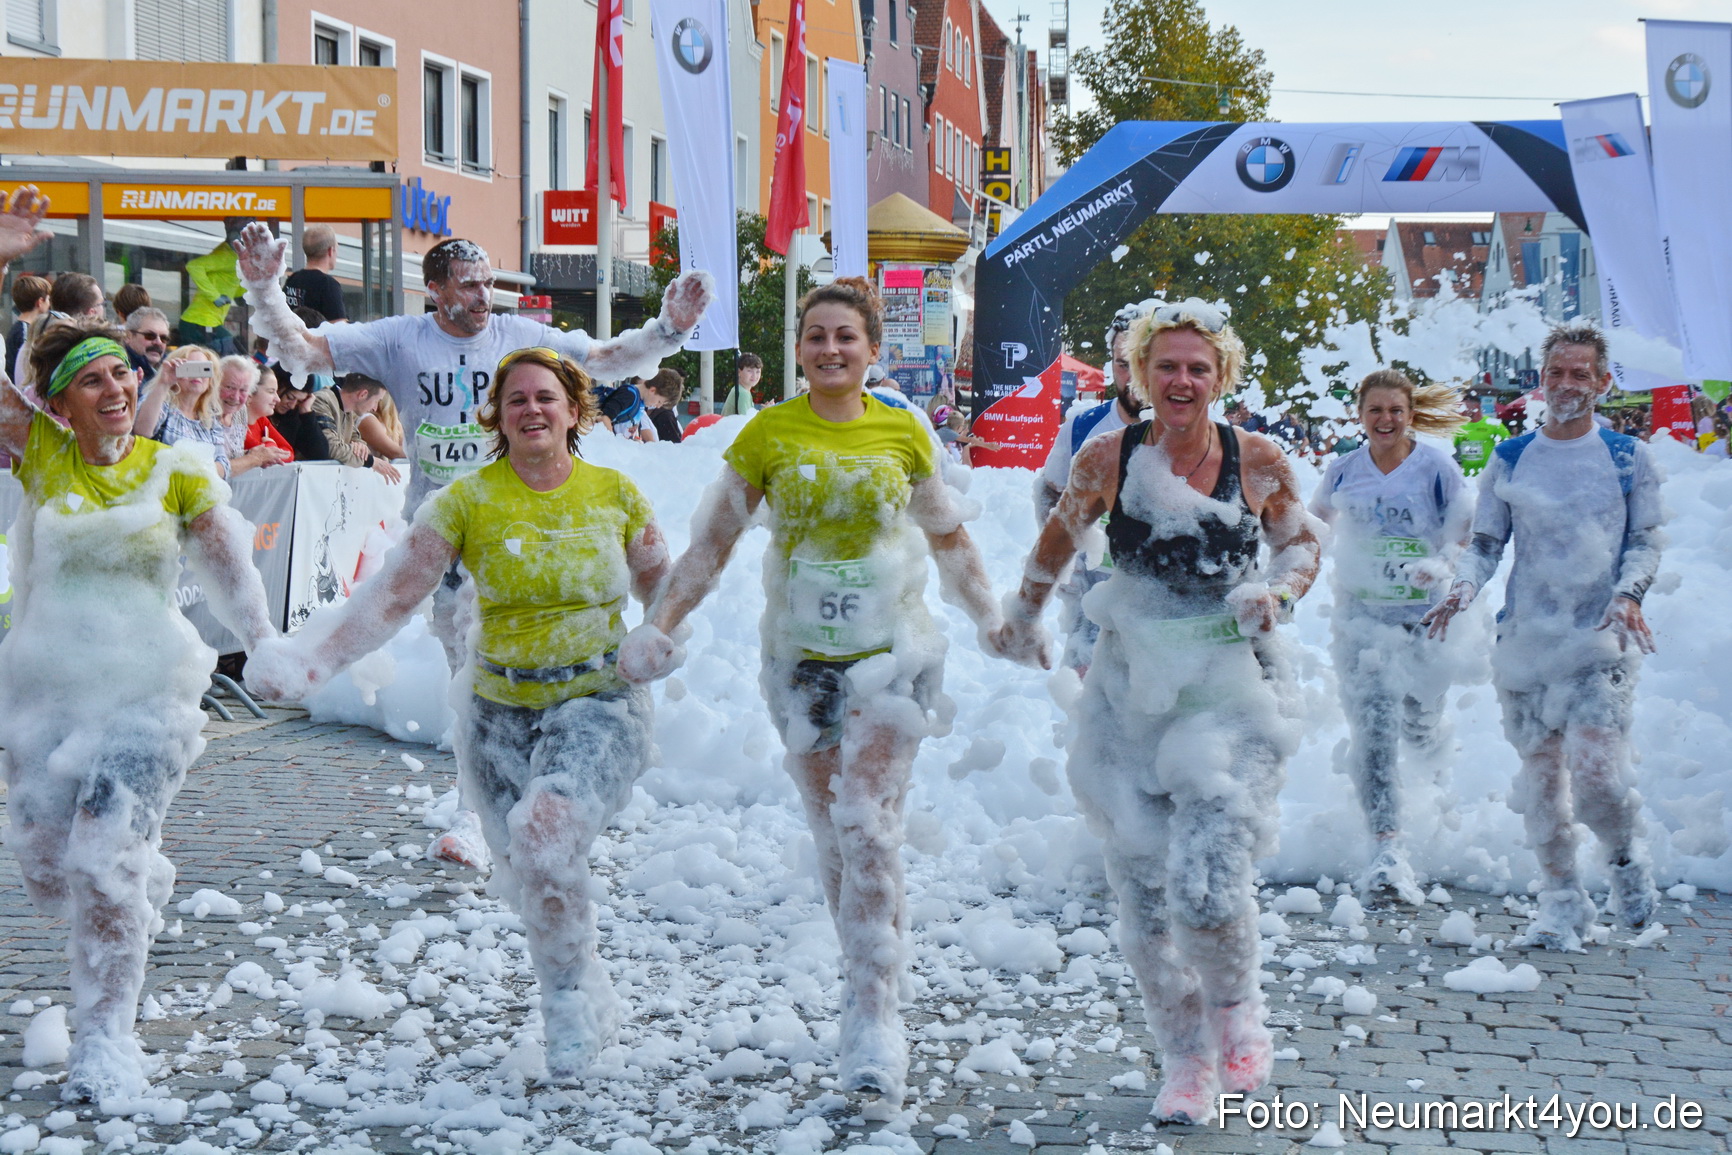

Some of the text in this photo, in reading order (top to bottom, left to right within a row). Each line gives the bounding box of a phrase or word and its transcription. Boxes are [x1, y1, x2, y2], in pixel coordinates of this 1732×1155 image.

[121, 190, 277, 211] RUNMARKT.DE
[551, 208, 590, 223] WITT
[1004, 179, 1135, 269] PARTL NEUMARKT
[983, 412, 1044, 424] BMW Laufsport
[430, 442, 478, 462] 140
[819, 591, 860, 622] 66
